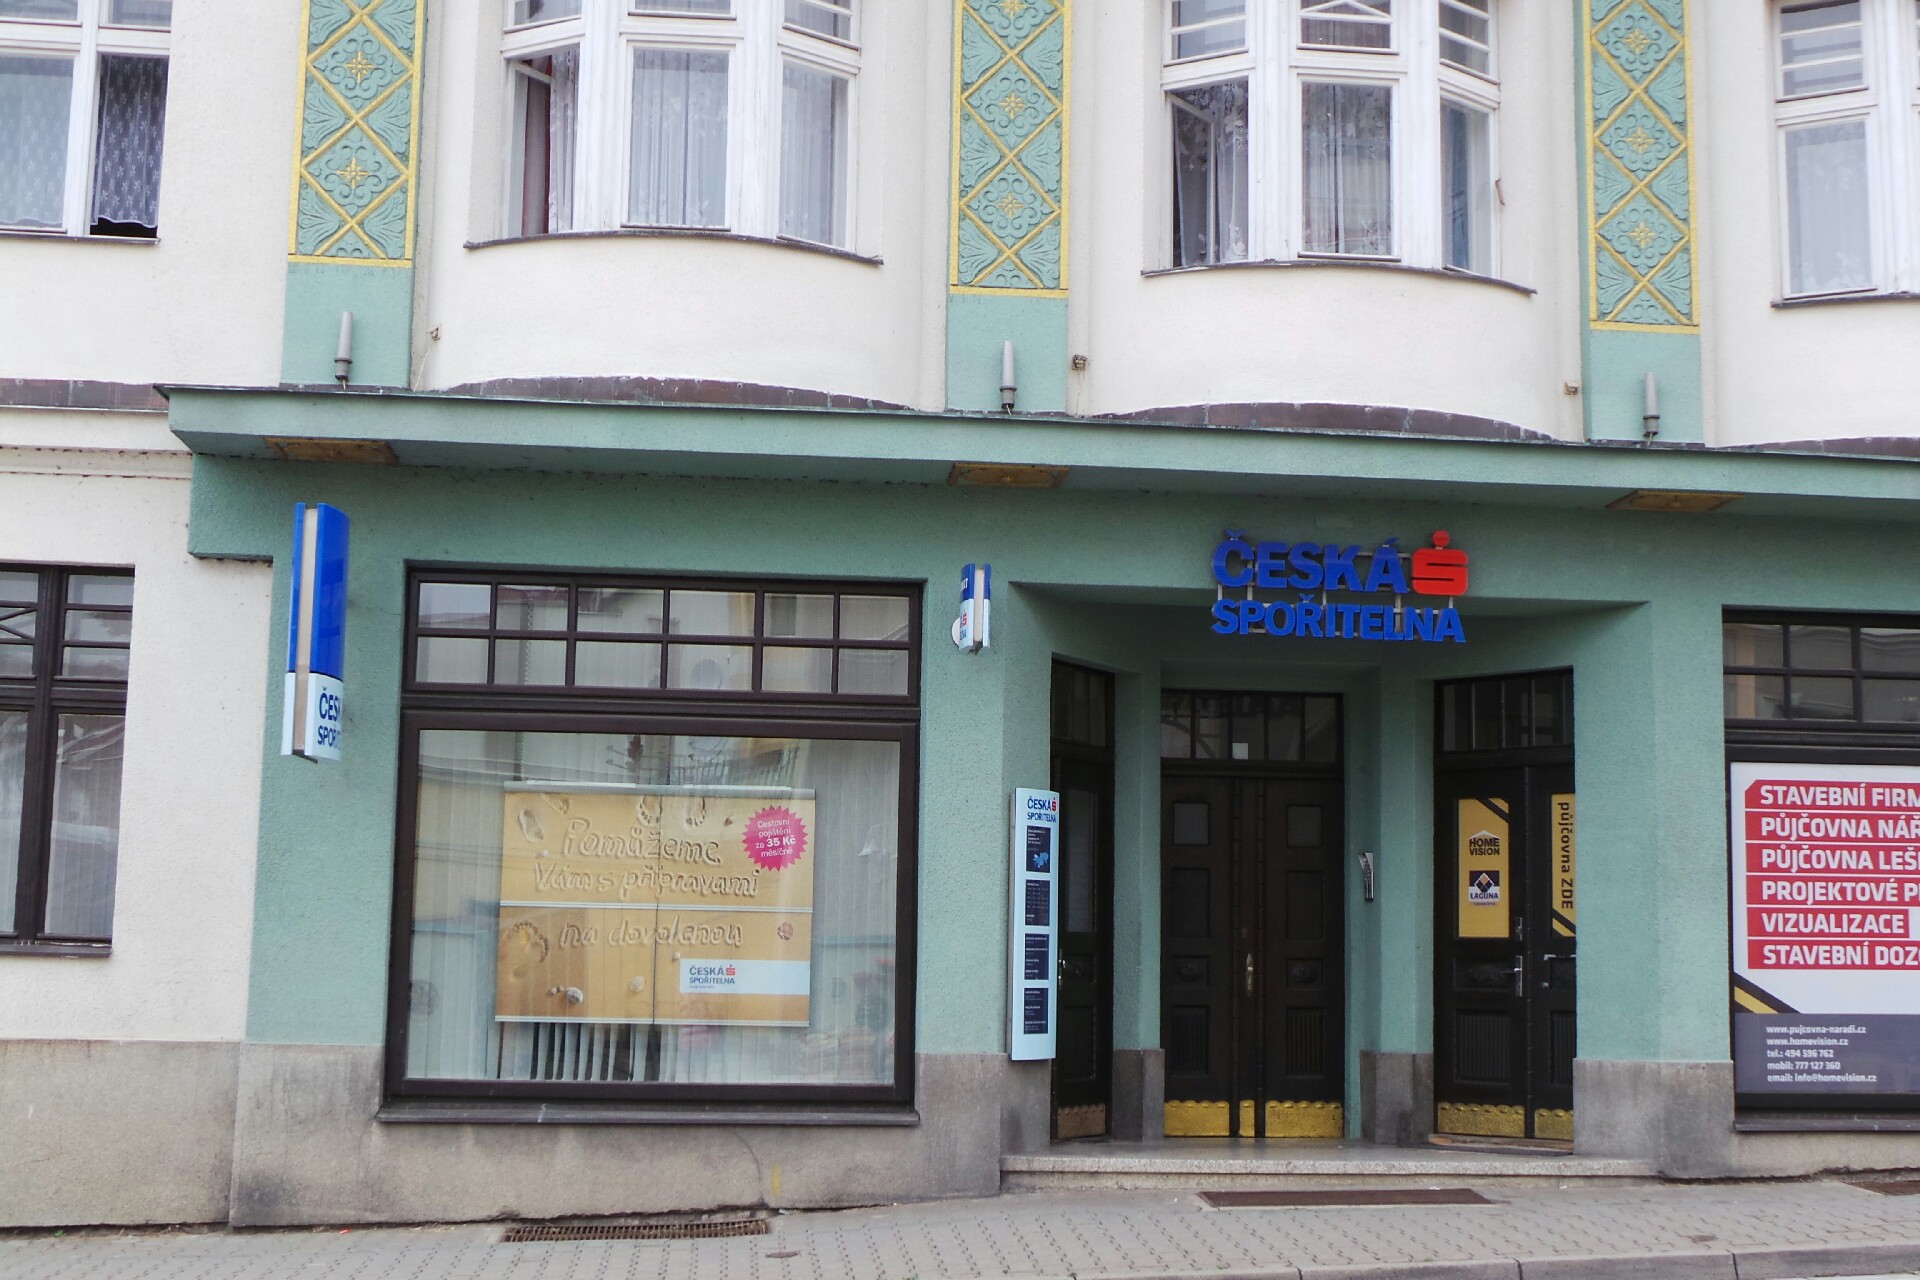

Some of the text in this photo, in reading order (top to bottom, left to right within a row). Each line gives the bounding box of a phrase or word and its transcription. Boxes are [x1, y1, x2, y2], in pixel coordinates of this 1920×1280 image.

[1212, 528, 1408, 594] ČESKÁ
[1211, 593, 1466, 643] SPOŘITELNA
[1760, 783, 1866, 806] STAVEBNÍ
[1027, 796, 1051, 811] ČESKÁ
[757, 819, 790, 829] Cestovní
[1761, 812, 1873, 841] PŮJČOVNA
[758, 828, 791, 838] pojištění
[562, 816, 722, 866] Pomůžeme
[766, 837, 780, 848] 35
[782, 834, 796, 846] Kč
[1469, 837, 1500, 848] HOME
[761, 847, 793, 858] měsíčně
[1469, 847, 1500, 856] VISION
[1558, 802, 1573, 909] půjčovna ZDE
[1762, 844, 1920, 873] PŮJČOVNA LEŠ
[534, 861, 592, 892] Vám
[598, 871, 616, 892] s
[1762, 878, 1898, 905] PROJEKTOVÉ
[1761, 912, 1905, 934] VIZUALIZACE
[559, 915, 744, 949] na dovolenou
[1763, 941, 1920, 966] STAVEBNÍ DOZ
[689, 964, 725, 976] ČESKÁ
[689, 975, 735, 985] SPOŘITELNA
[1766, 1025, 1867, 1035] www.pujcovna-naradi.cz
[1766, 1037, 1848, 1046] www.homevision.cz
[1766, 1049, 1784, 1058] tel.:
[1784, 1049, 1801, 1058] 494
[1819, 1049, 1834, 1058] 762
[1767, 1061, 1841, 1070] mobil: 777 127 360
[1767, 1073, 1877, 1082] email: info@homevision.cz
